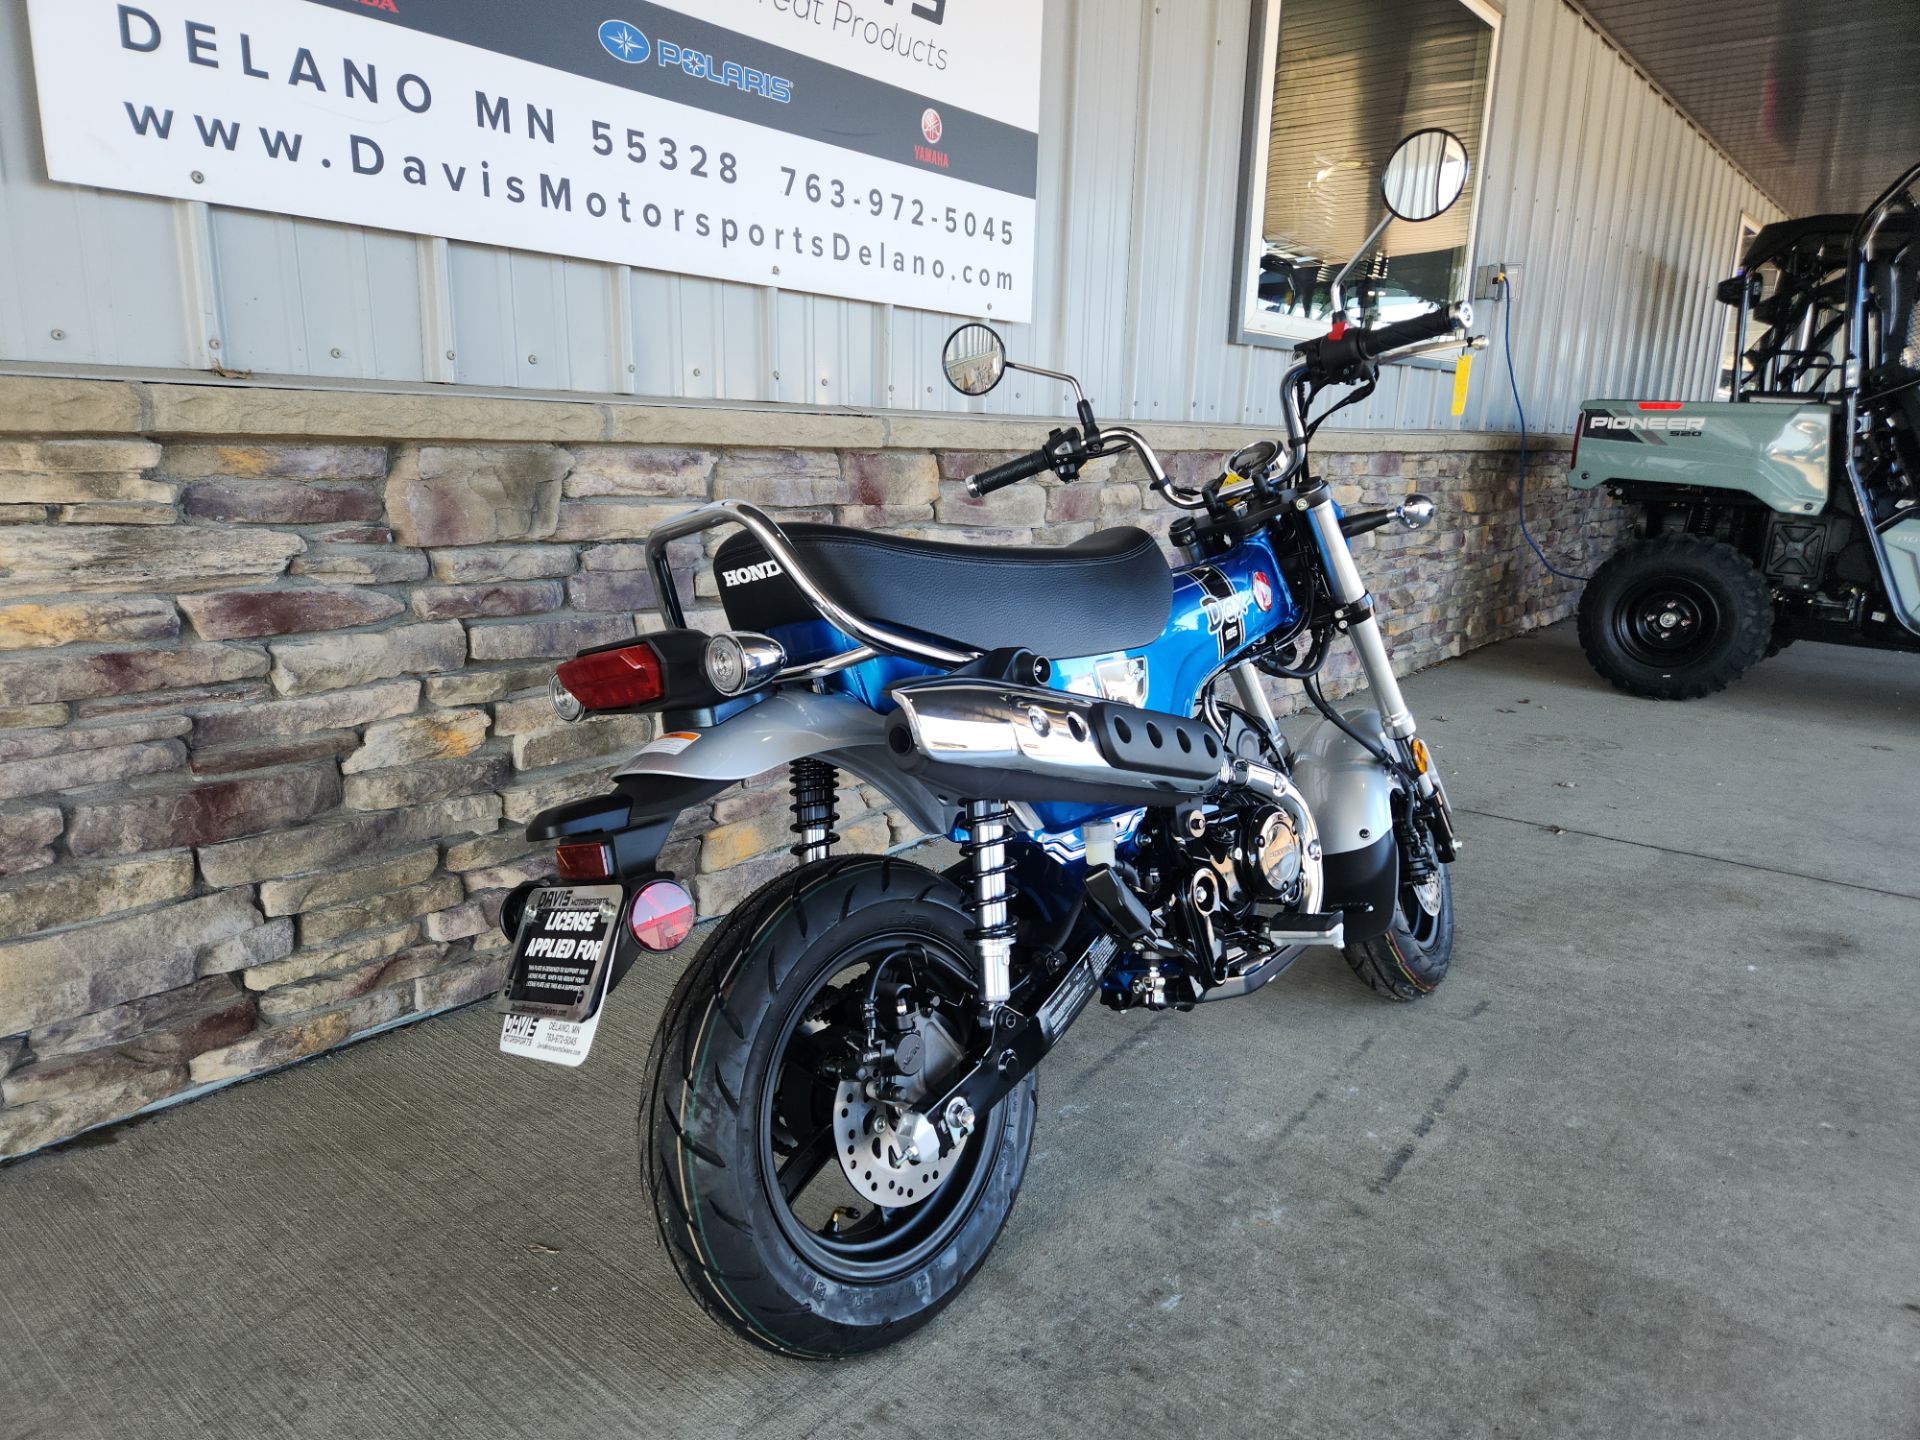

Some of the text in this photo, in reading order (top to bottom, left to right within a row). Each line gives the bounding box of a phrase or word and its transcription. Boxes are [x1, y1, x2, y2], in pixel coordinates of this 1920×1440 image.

[833, 0, 948, 70] Products
[657, 40, 791, 103] POLARIS
[117, 3, 1013, 245] DELANO MN 55328 763-972-5045
[914, 144, 949, 168] YAMAHA
[123, 101, 1013, 291] www.DavisMotorsportsDelano.com
[1590, 416, 1706, 430] PIONEER
[723, 560, 783, 587] HOND
[538, 890, 573, 907] DAVIS
[544, 911, 600, 932] LICENSE
[525, 937, 604, 961] APPLIED FOR
